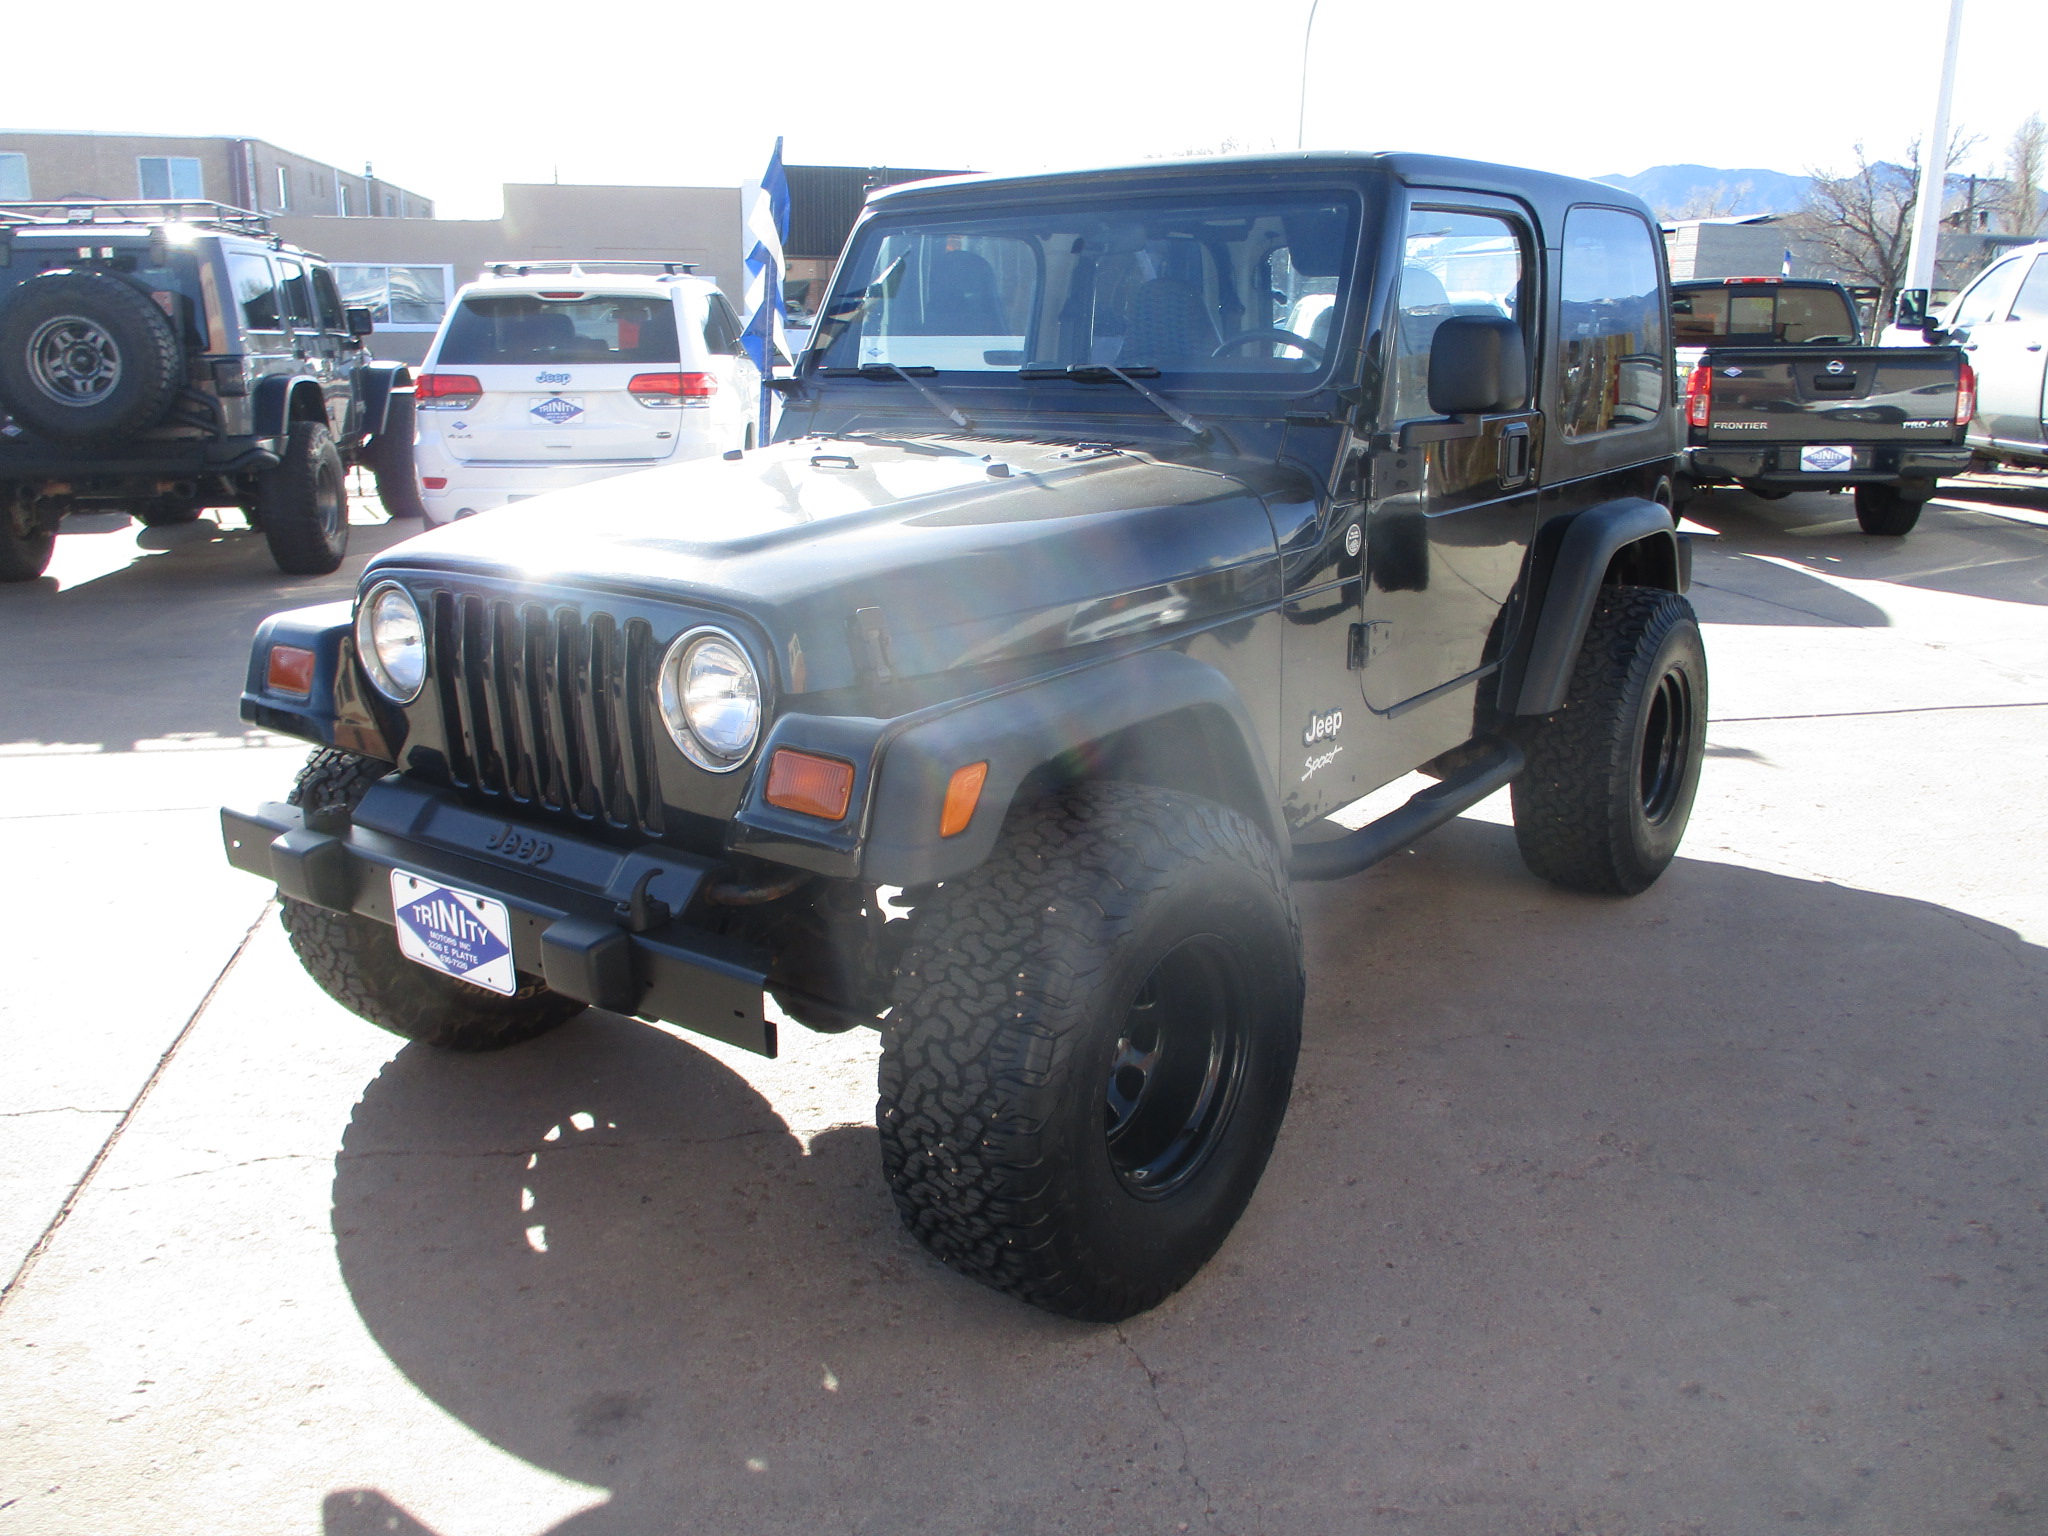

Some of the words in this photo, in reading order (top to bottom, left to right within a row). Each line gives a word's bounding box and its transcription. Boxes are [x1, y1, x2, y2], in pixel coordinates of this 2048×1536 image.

[536, 370, 572, 386] Jeep
[539, 401, 575, 413] TRINITY
[1713, 421, 1768, 430] FRONTIER
[1902, 420, 1949, 430] PRO-4X
[1810, 449, 1843, 461] TRINITY
[1304, 710, 1343, 743] Jeep
[485, 823, 555, 867] Jeep
[412, 899, 488, 946] TRINITY
[429, 930, 457, 947] MOTORS
[451, 948, 479, 965] PLATTE
